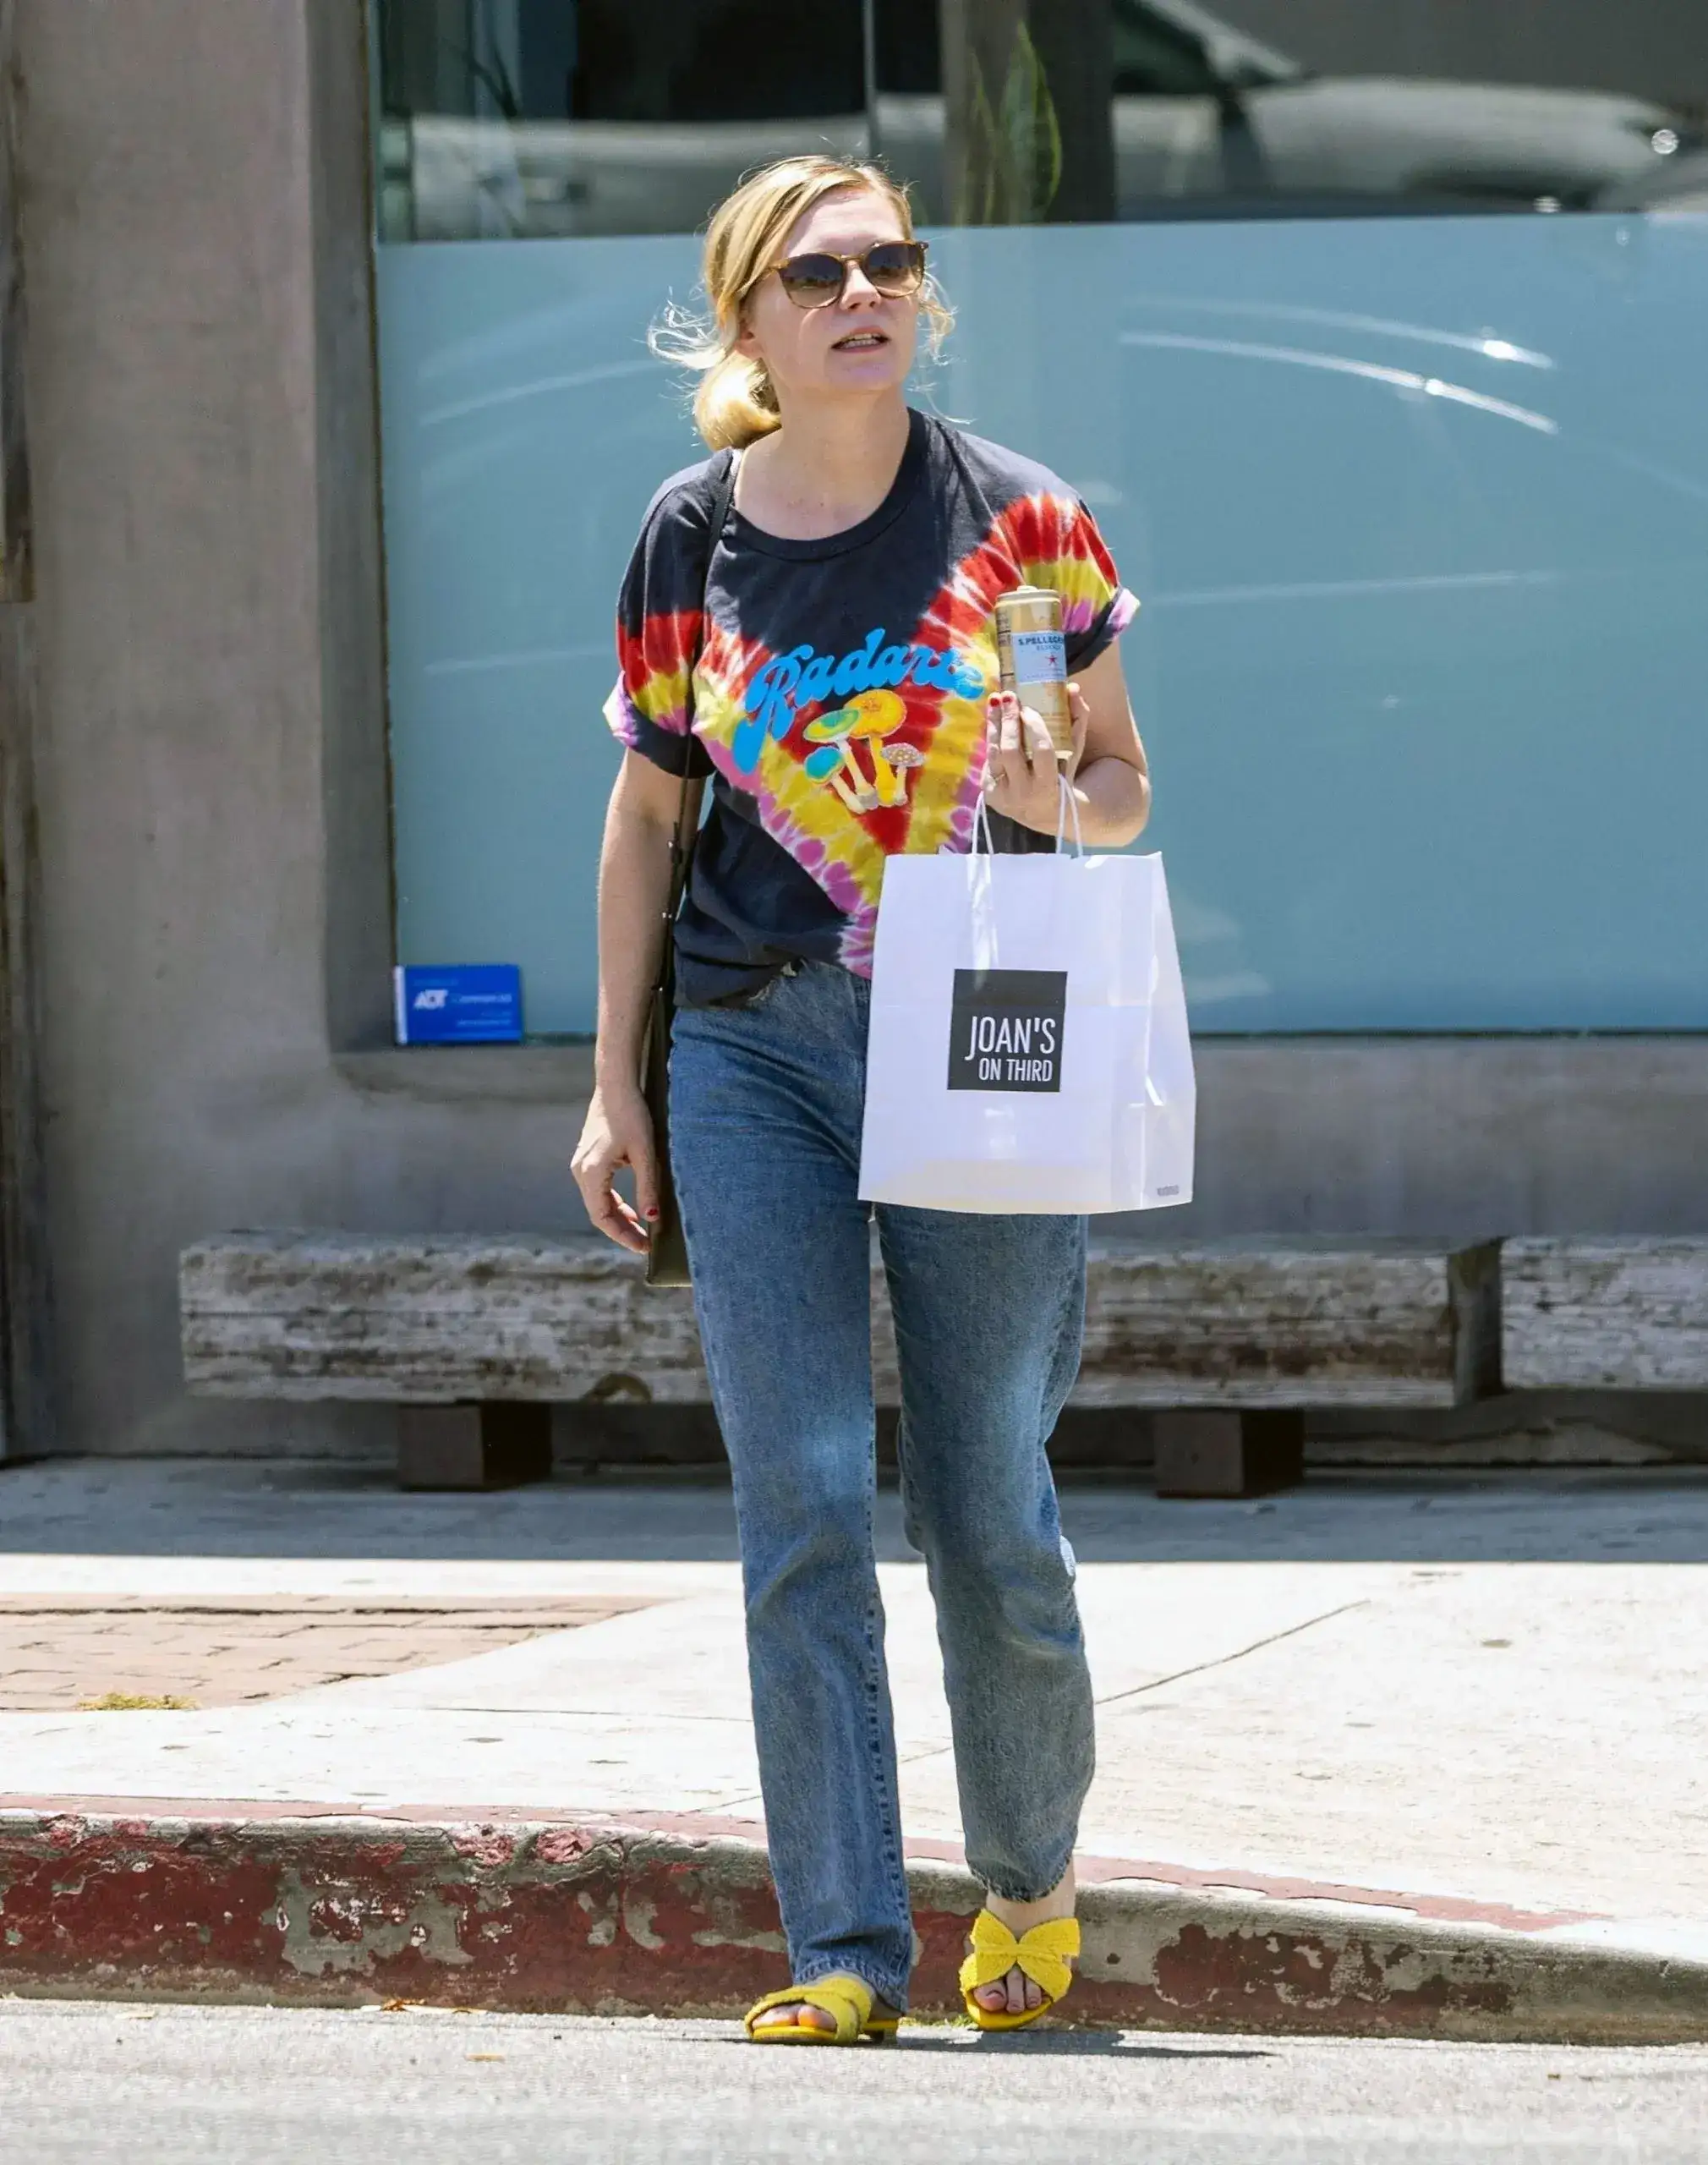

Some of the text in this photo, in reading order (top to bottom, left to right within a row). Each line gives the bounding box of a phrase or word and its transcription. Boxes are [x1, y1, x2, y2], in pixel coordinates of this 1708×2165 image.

[413, 989, 448, 1009] ADT
[964, 1016, 1056, 1061] JOAN'S
[978, 1057, 1053, 1082] ON THIRD
